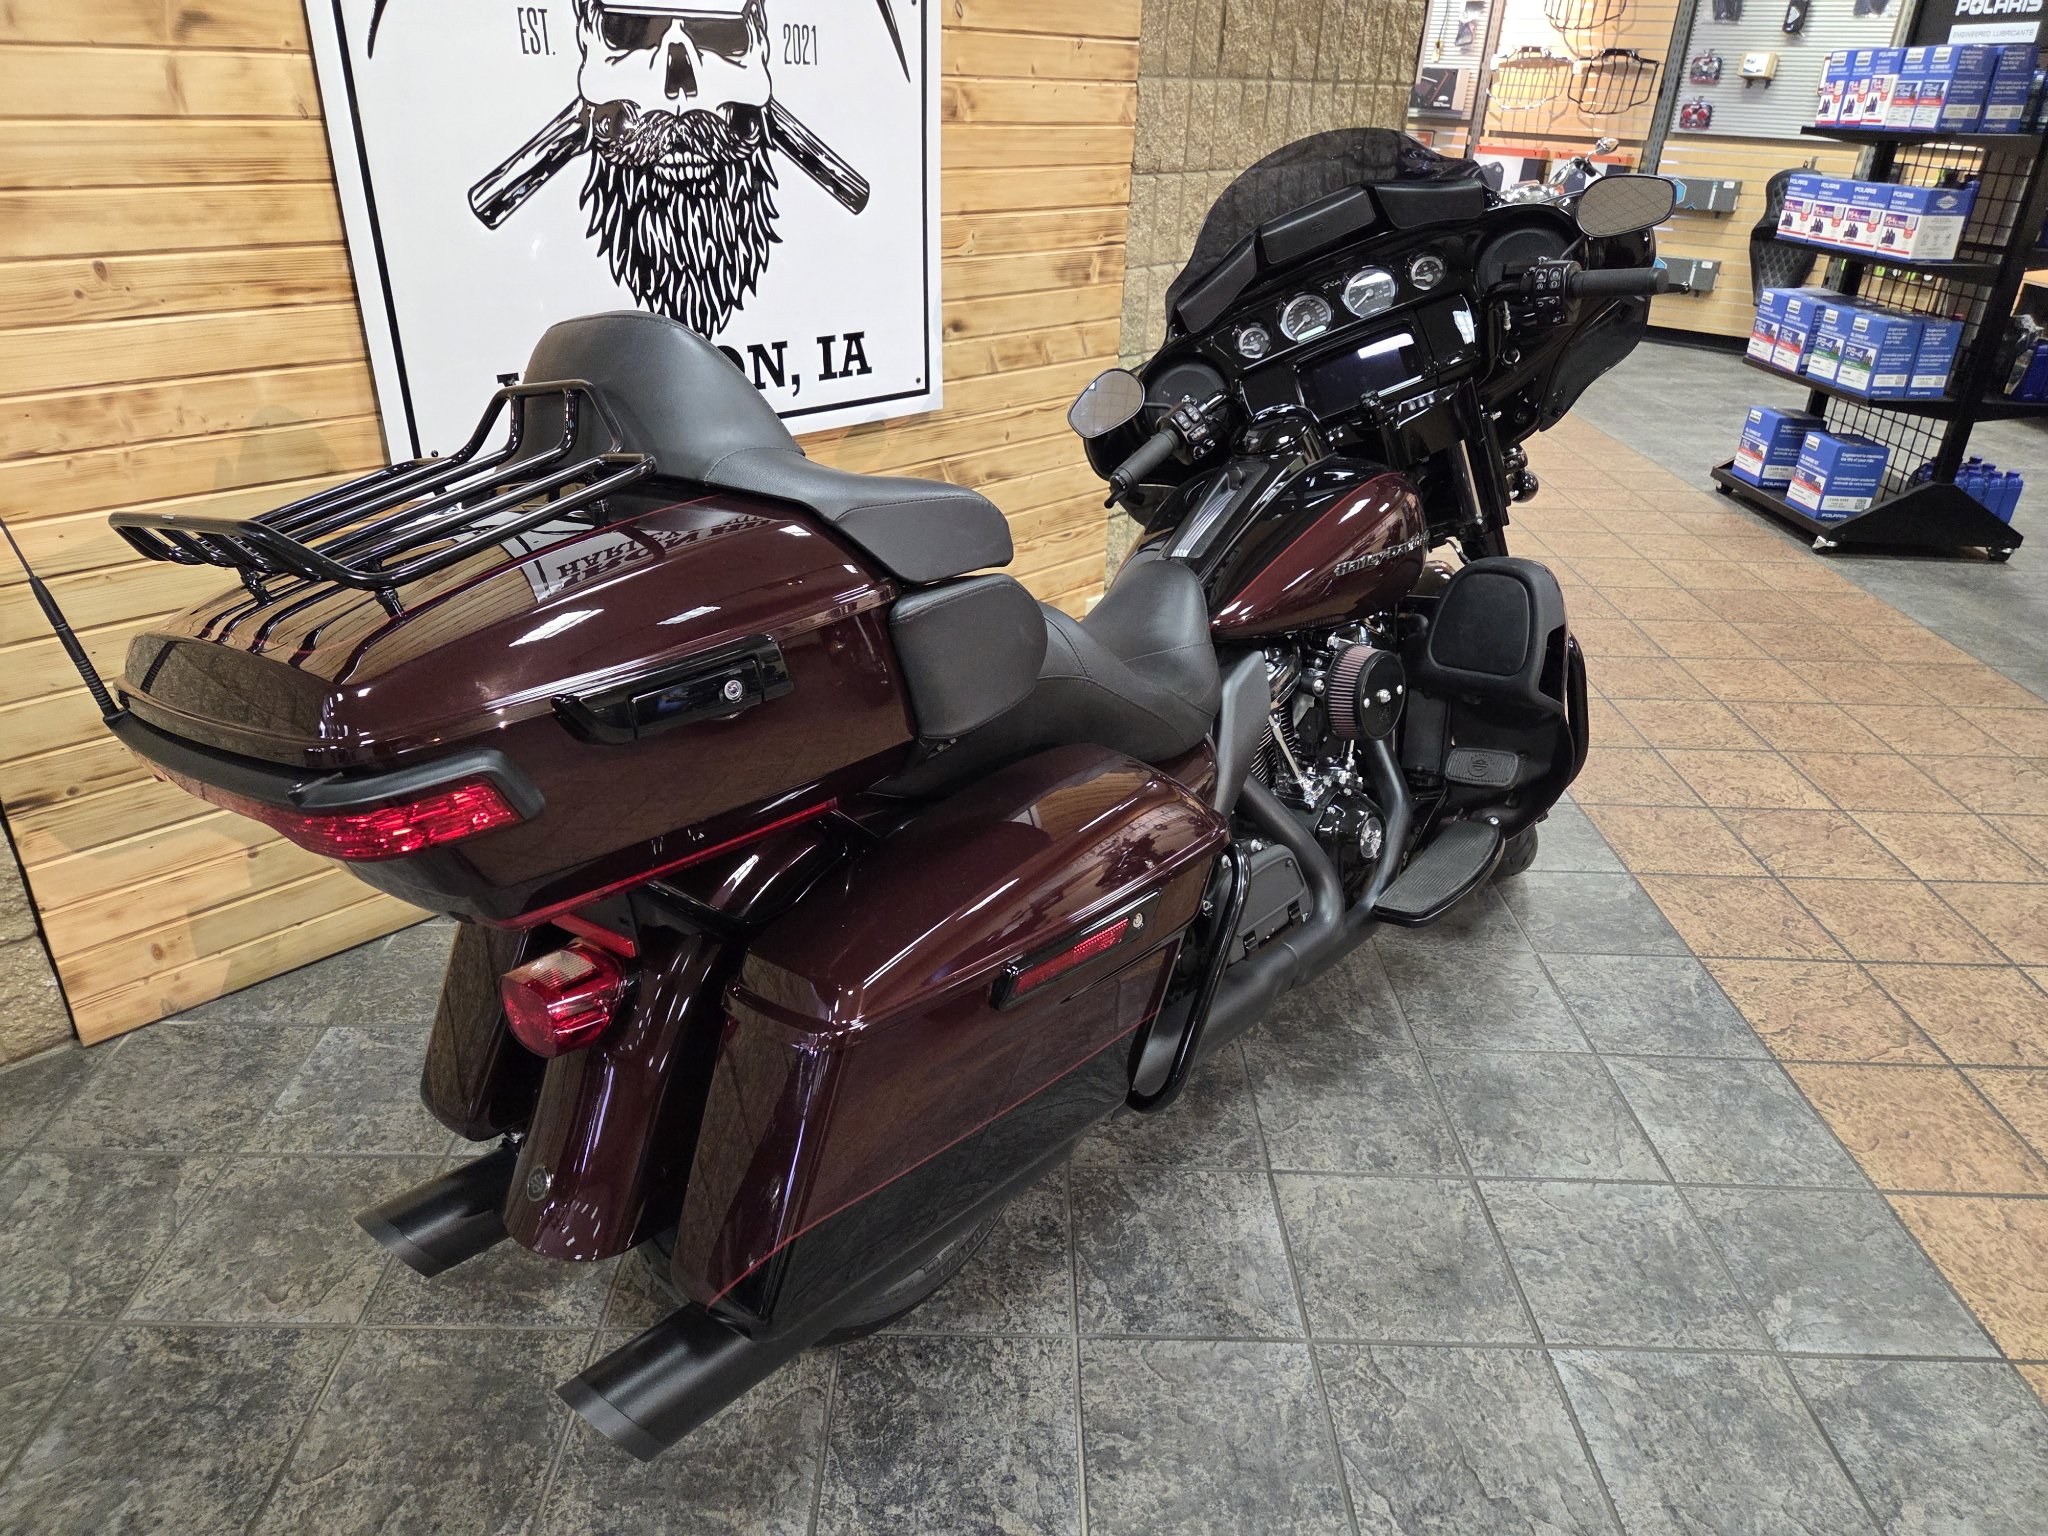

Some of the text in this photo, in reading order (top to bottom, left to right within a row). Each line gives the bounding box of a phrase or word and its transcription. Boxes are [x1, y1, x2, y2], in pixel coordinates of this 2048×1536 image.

[1955, 0, 2043, 16] POLARIS
[517, 7, 556, 55] EST.
[783, 23, 817, 66] 2021
[817, 331, 872, 381] IA
